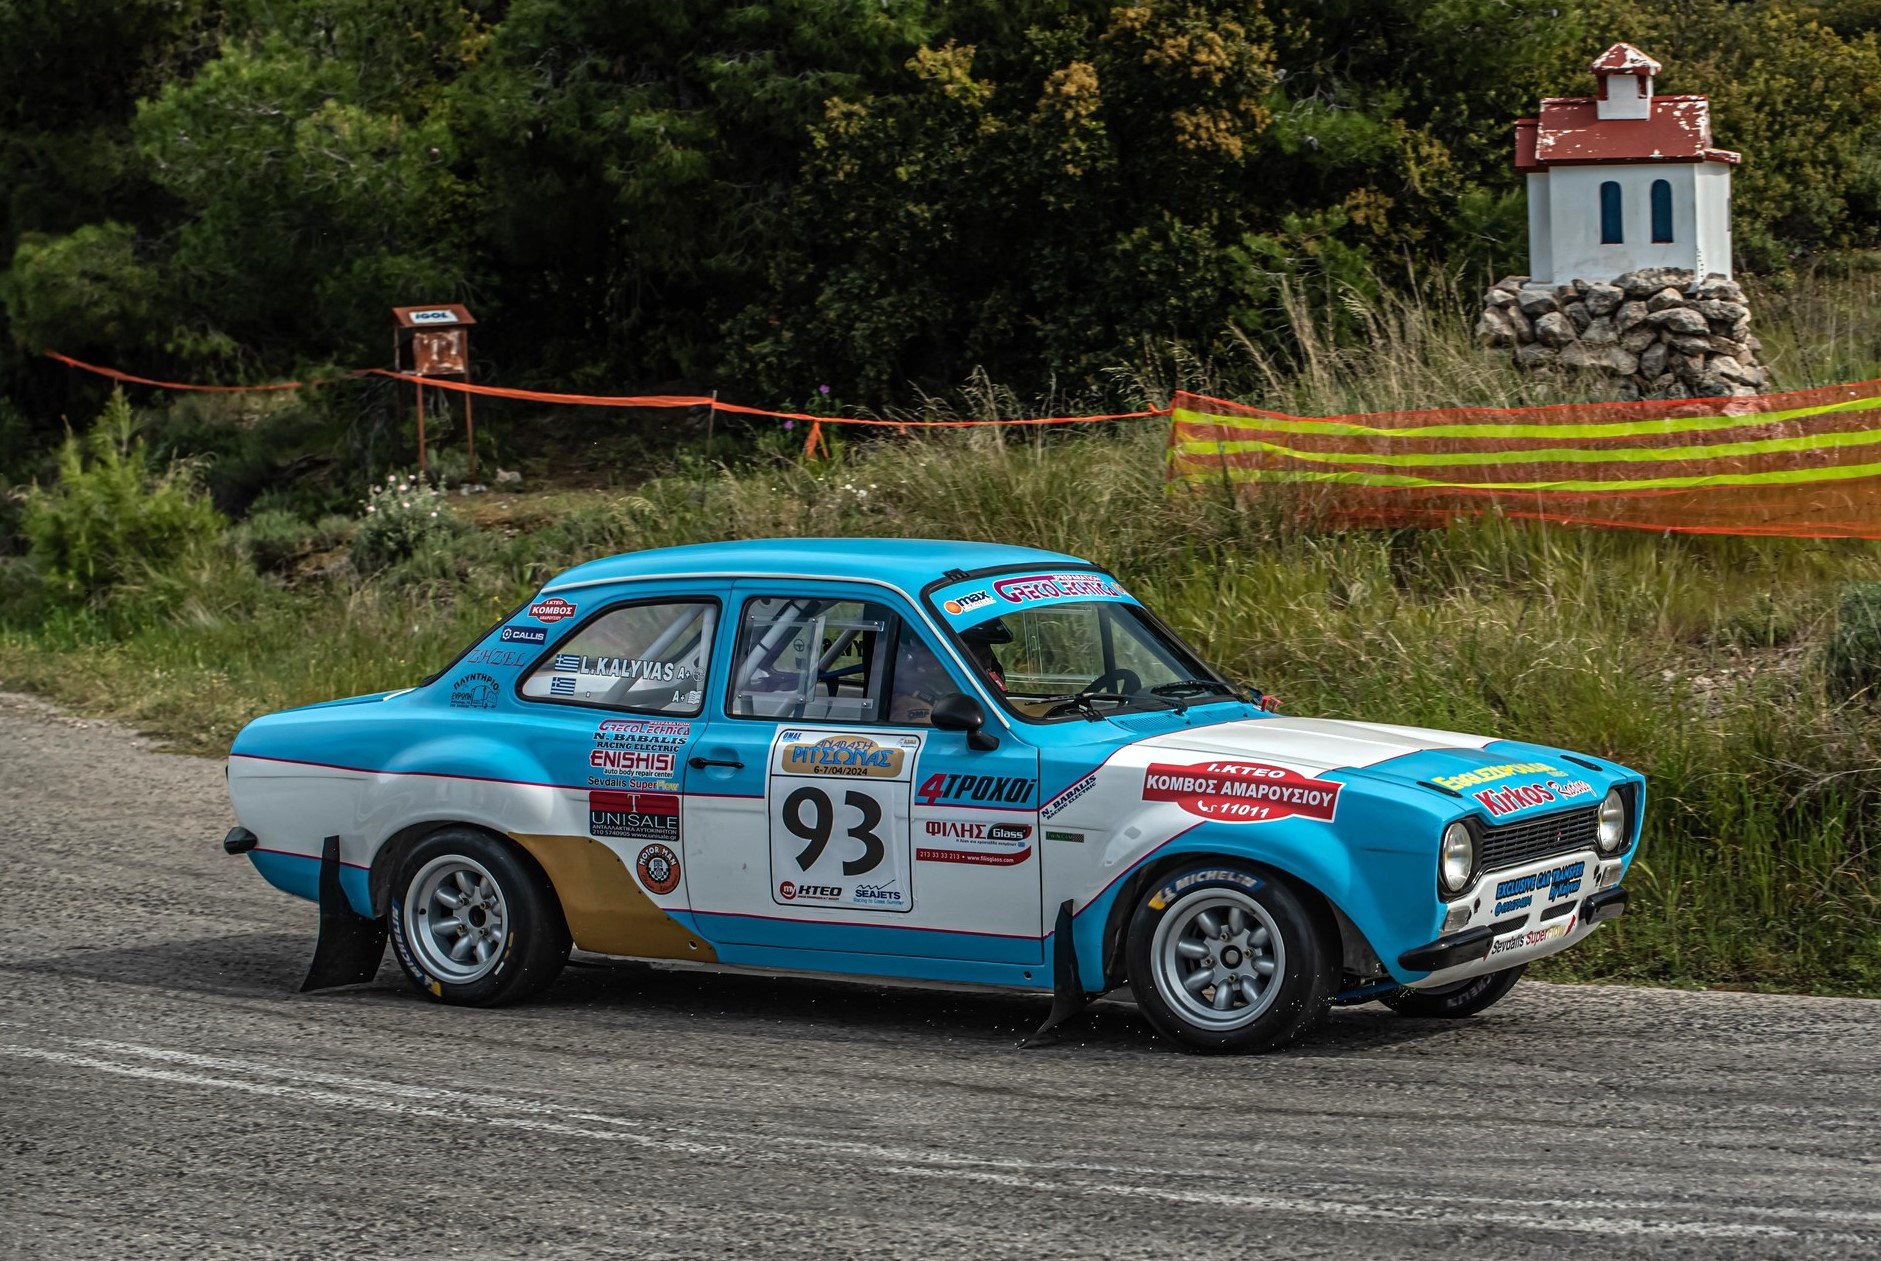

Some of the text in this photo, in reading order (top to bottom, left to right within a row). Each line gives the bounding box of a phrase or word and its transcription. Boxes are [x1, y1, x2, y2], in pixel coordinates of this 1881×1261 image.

[532, 606, 573, 614] ΚΟΜΒΟΣ
[512, 631, 545, 640] CALLIS
[581, 656, 675, 681] L.KALYVAS
[453, 672, 500, 691] ΠΛΥΝΤΗΡΙΟ
[593, 732, 687, 744] N. BABALIS
[816, 740, 874, 750] ΑΝΑΒΑΣΗ
[634, 744, 679, 752] ELECTRIC
[792, 746, 895, 768] ΡΙΤΣΩΝΑΣ
[590, 750, 675, 771] ENISHISI
[619, 769, 634, 777] body
[635, 770, 653, 778] repair
[814, 766, 868, 776] 6-7/04/2024
[588, 776, 627, 787] Sevdalis
[1041, 775, 1097, 818] N. BABALIS
[1147, 775, 1334, 807] ΚΟΜΒΟΣ ΑΜΑΡΟΥΣΙΟΥ
[1475, 784, 1554, 816] Kirkos
[1046, 782, 1097, 820] RACING ELECTRIC
[1220, 803, 1270, 819] 11011
[592, 812, 678, 829] UNISALE
[782, 786, 885, 876] 93
[926, 821, 1024, 839] ΦΙΛΗΣ Glass
[639, 846, 677, 866] MOTOR MAN
[950, 852, 960, 860] 213
[967, 855, 1015, 863] www.filisglass.com
[1175, 870, 1258, 891] MICHELIN
[1495, 861, 1585, 900] EXCLUSIVE CAR TRANSFER
[855, 889, 901, 900] SEAJETS
[1491, 935, 1524, 954] Sevdalis
